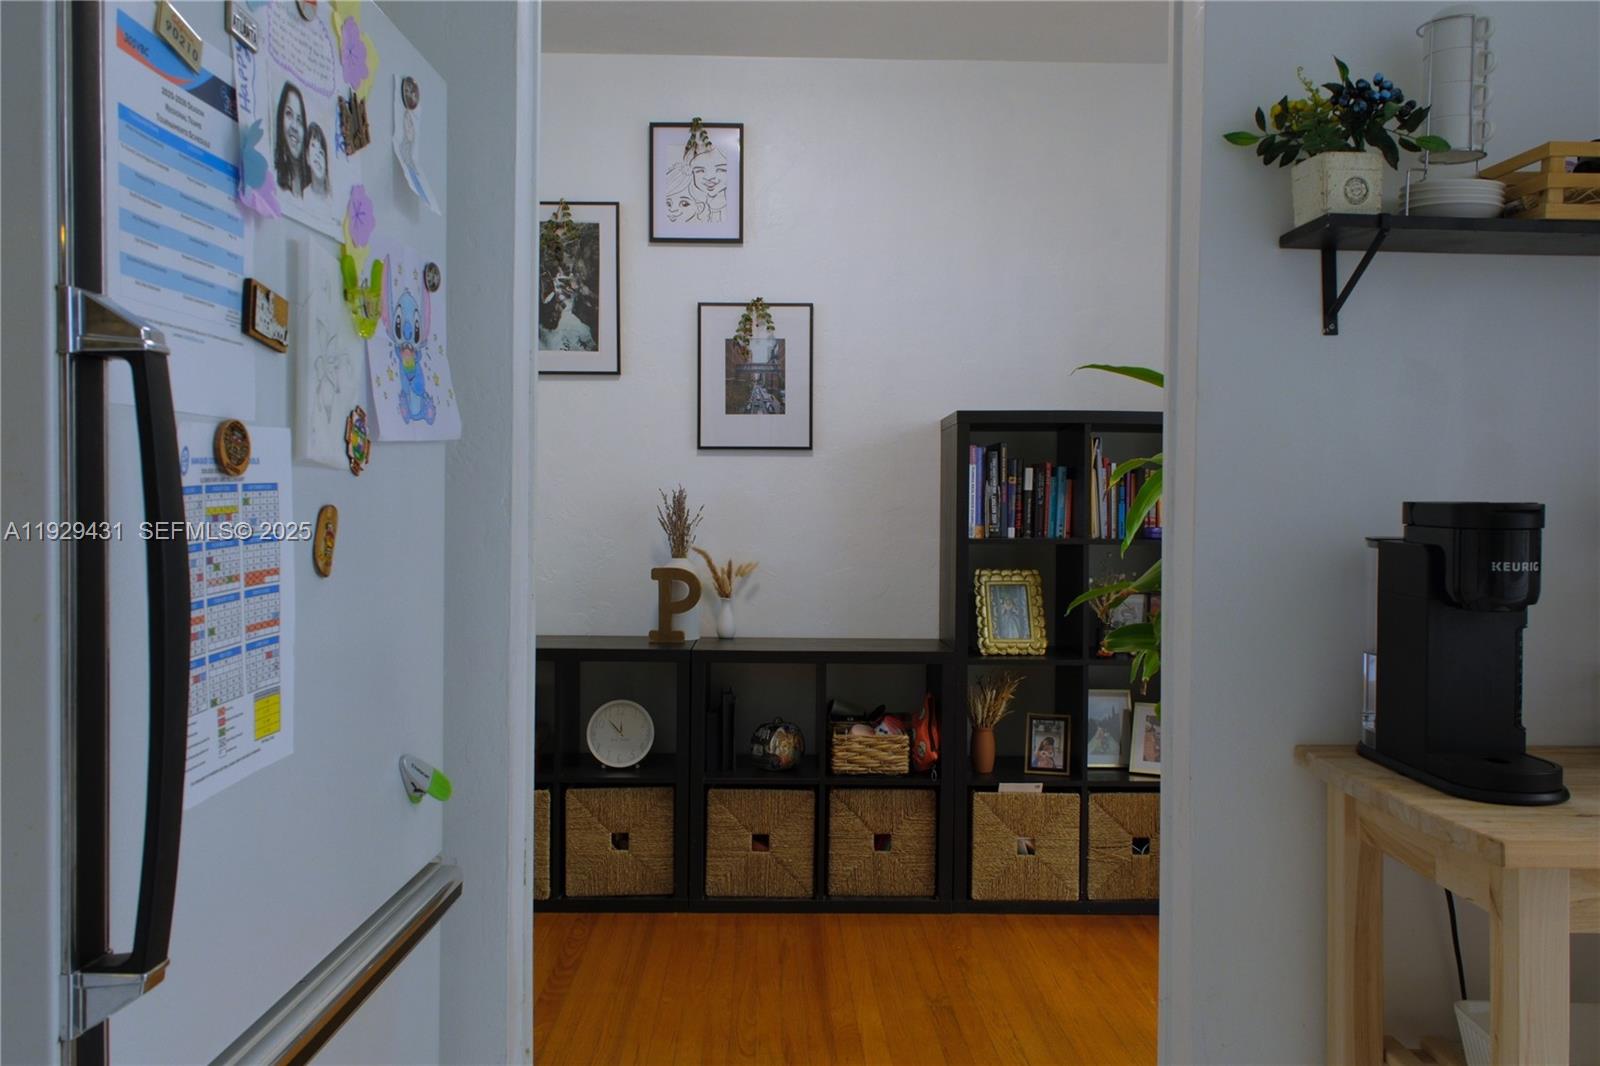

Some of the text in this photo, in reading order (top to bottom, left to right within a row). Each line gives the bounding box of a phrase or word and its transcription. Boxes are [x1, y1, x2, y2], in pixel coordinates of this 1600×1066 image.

[165, 19, 199, 62] 90210
[1491, 561, 1540, 572] KEURIG
[649, 567, 701, 645] P
